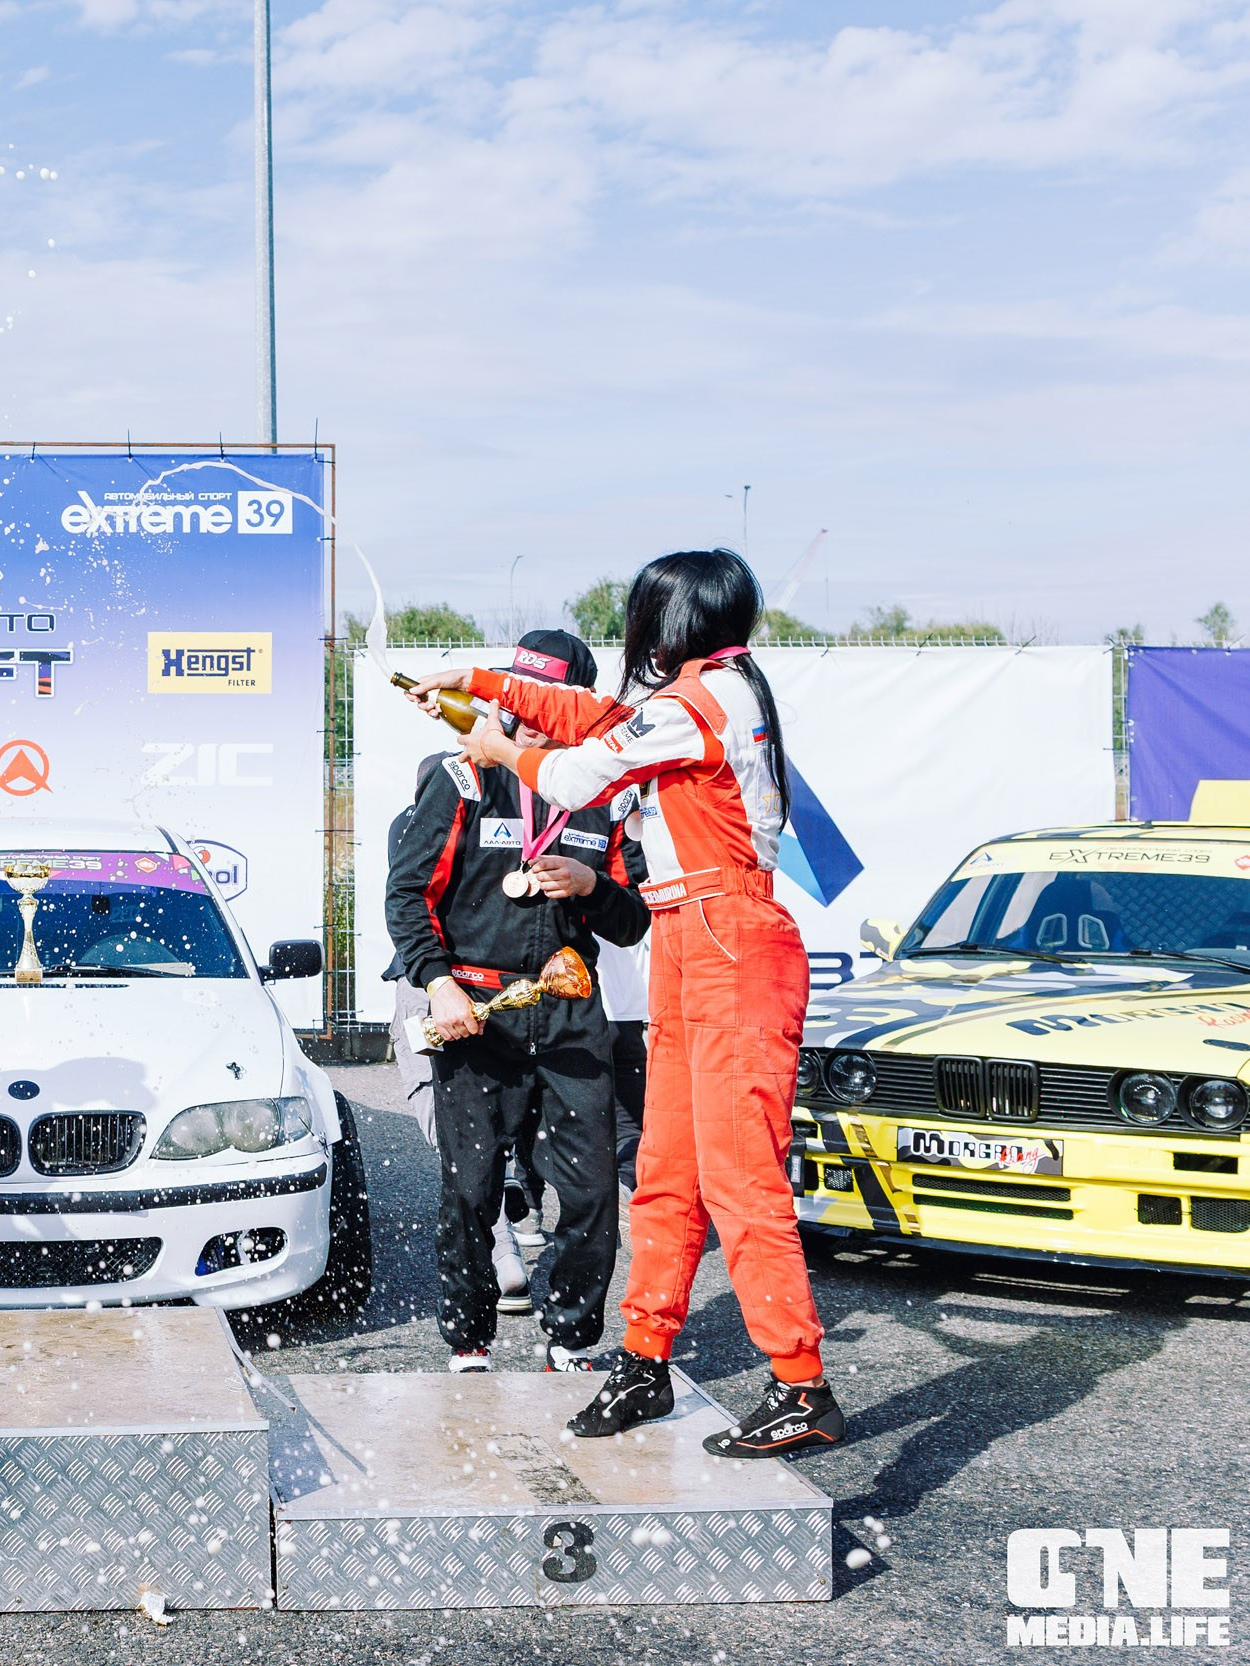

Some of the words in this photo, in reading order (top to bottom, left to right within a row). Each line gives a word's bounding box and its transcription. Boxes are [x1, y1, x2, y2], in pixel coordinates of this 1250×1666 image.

[198, 492, 232, 501] СПОРТ
[61, 491, 233, 534] extreme
[245, 499, 285, 528] 39
[161, 647, 256, 677] Hengst
[141, 743, 274, 786] ZIC
[448, 760, 471, 792] sparco
[1049, 849, 1210, 865] EXTREME39
[451, 968, 484, 981] sparco
[770, 1421, 809, 1441] sparco
[543, 1521, 597, 1583] 3
